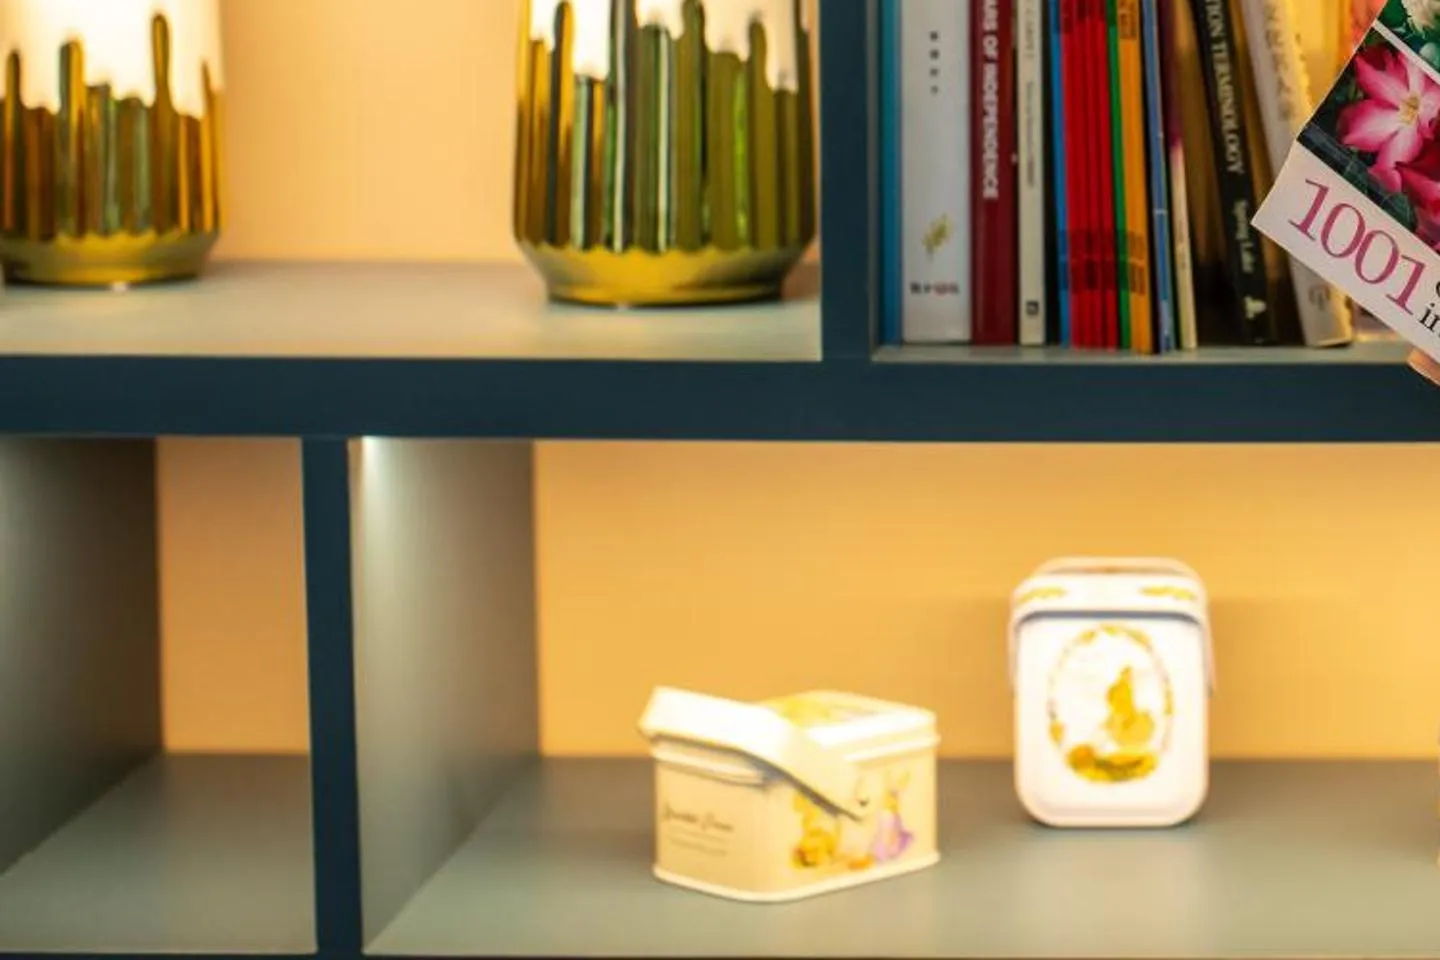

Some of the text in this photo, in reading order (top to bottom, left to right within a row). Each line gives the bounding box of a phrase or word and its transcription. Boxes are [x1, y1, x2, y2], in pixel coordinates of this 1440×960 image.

[981, 34, 999, 58] OF
[1210, 41, 1246, 174] TERMINOLOGY
[981, 62, 999, 199] INDEPENDENCE
[1288, 178, 1426, 316] 1001
